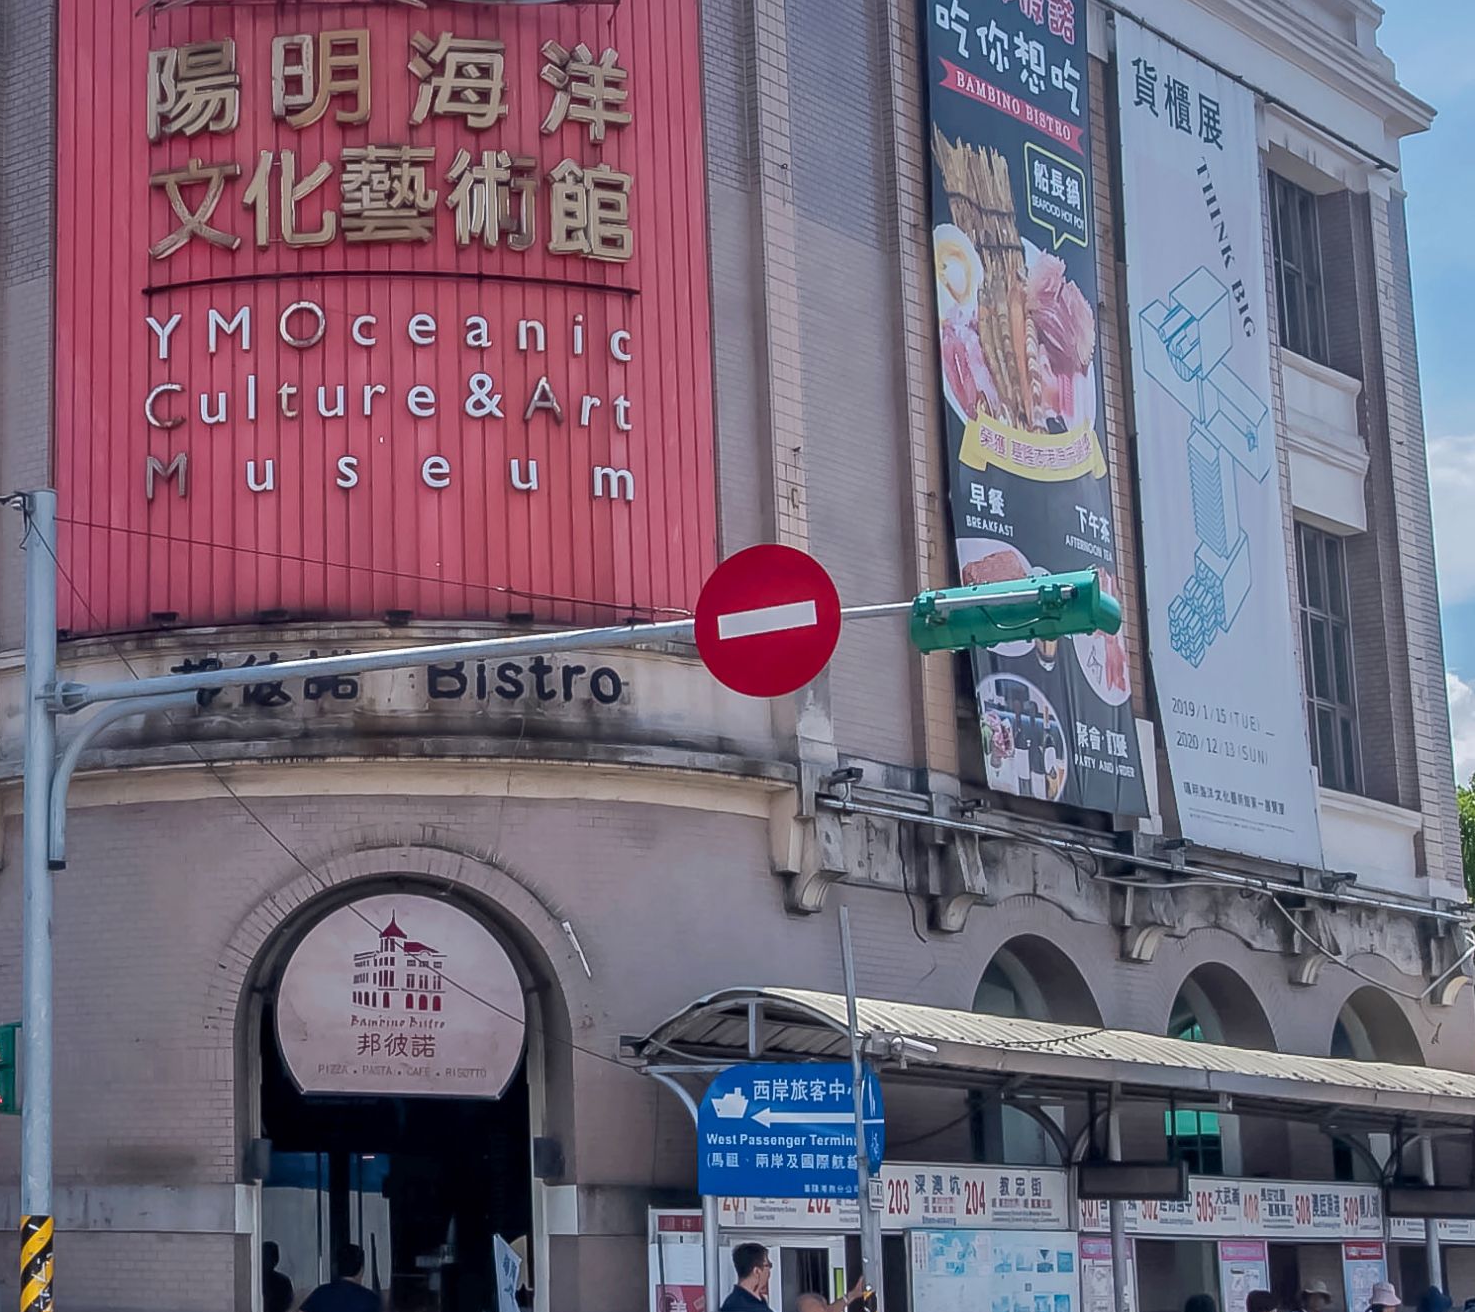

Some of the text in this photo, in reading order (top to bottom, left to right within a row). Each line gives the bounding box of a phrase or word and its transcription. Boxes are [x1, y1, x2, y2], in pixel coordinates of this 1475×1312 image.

[146, 27, 632, 144] 陽明海洋
[1131, 56, 1223, 150] 貨櫃展
[956, 70, 1071, 141] BAMBINO BISTRO
[148, 145, 634, 263] 文化藝術館
[1231, 279, 1256, 338] BIG
[144, 449, 636, 502] Museum
[969, 482, 1006, 518] 早餐
[965, 514, 1014, 537] BREAKFAST
[357, 1033, 436, 1057] 邦彼諾
[753, 1078, 852, 1102] 西岸旅客中
[707, 1133, 857, 1148] West Passenger Termin
[888, 1179, 910, 1215] 203
[965, 1180, 986, 1215] 204
